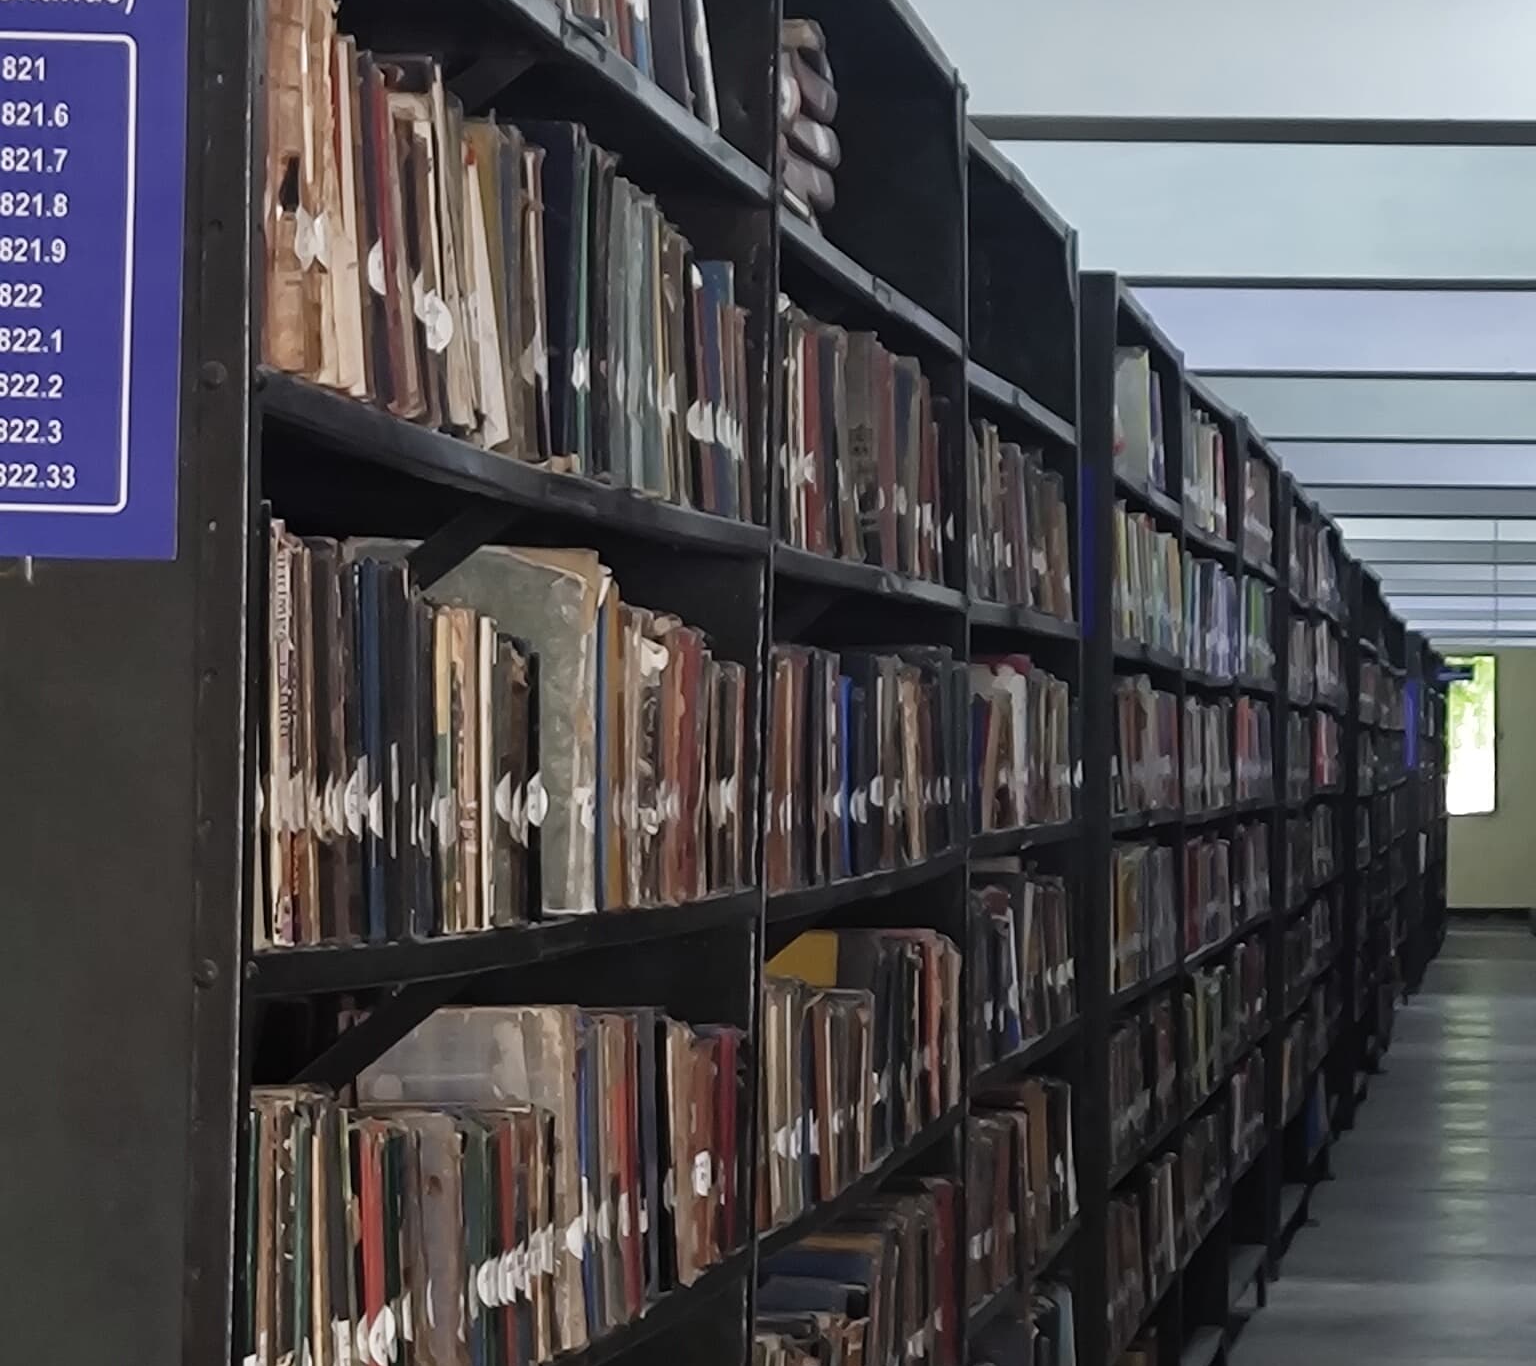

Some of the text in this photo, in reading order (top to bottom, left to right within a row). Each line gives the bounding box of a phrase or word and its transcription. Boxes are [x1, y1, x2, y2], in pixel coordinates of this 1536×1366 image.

[3, 56, 45, 81] 821
[2, 102, 69, 127] 821.6
[0, 147, 68, 172] 821.7
[0, 192, 68, 217] 821.8
[0, 238, 66, 263] 821.9
[0, 283, 43, 308] 822
[0, 328, 62, 353] 822.1
[0, 374, 63, 398] 822.2
[0, 419, 62, 443] 822.3
